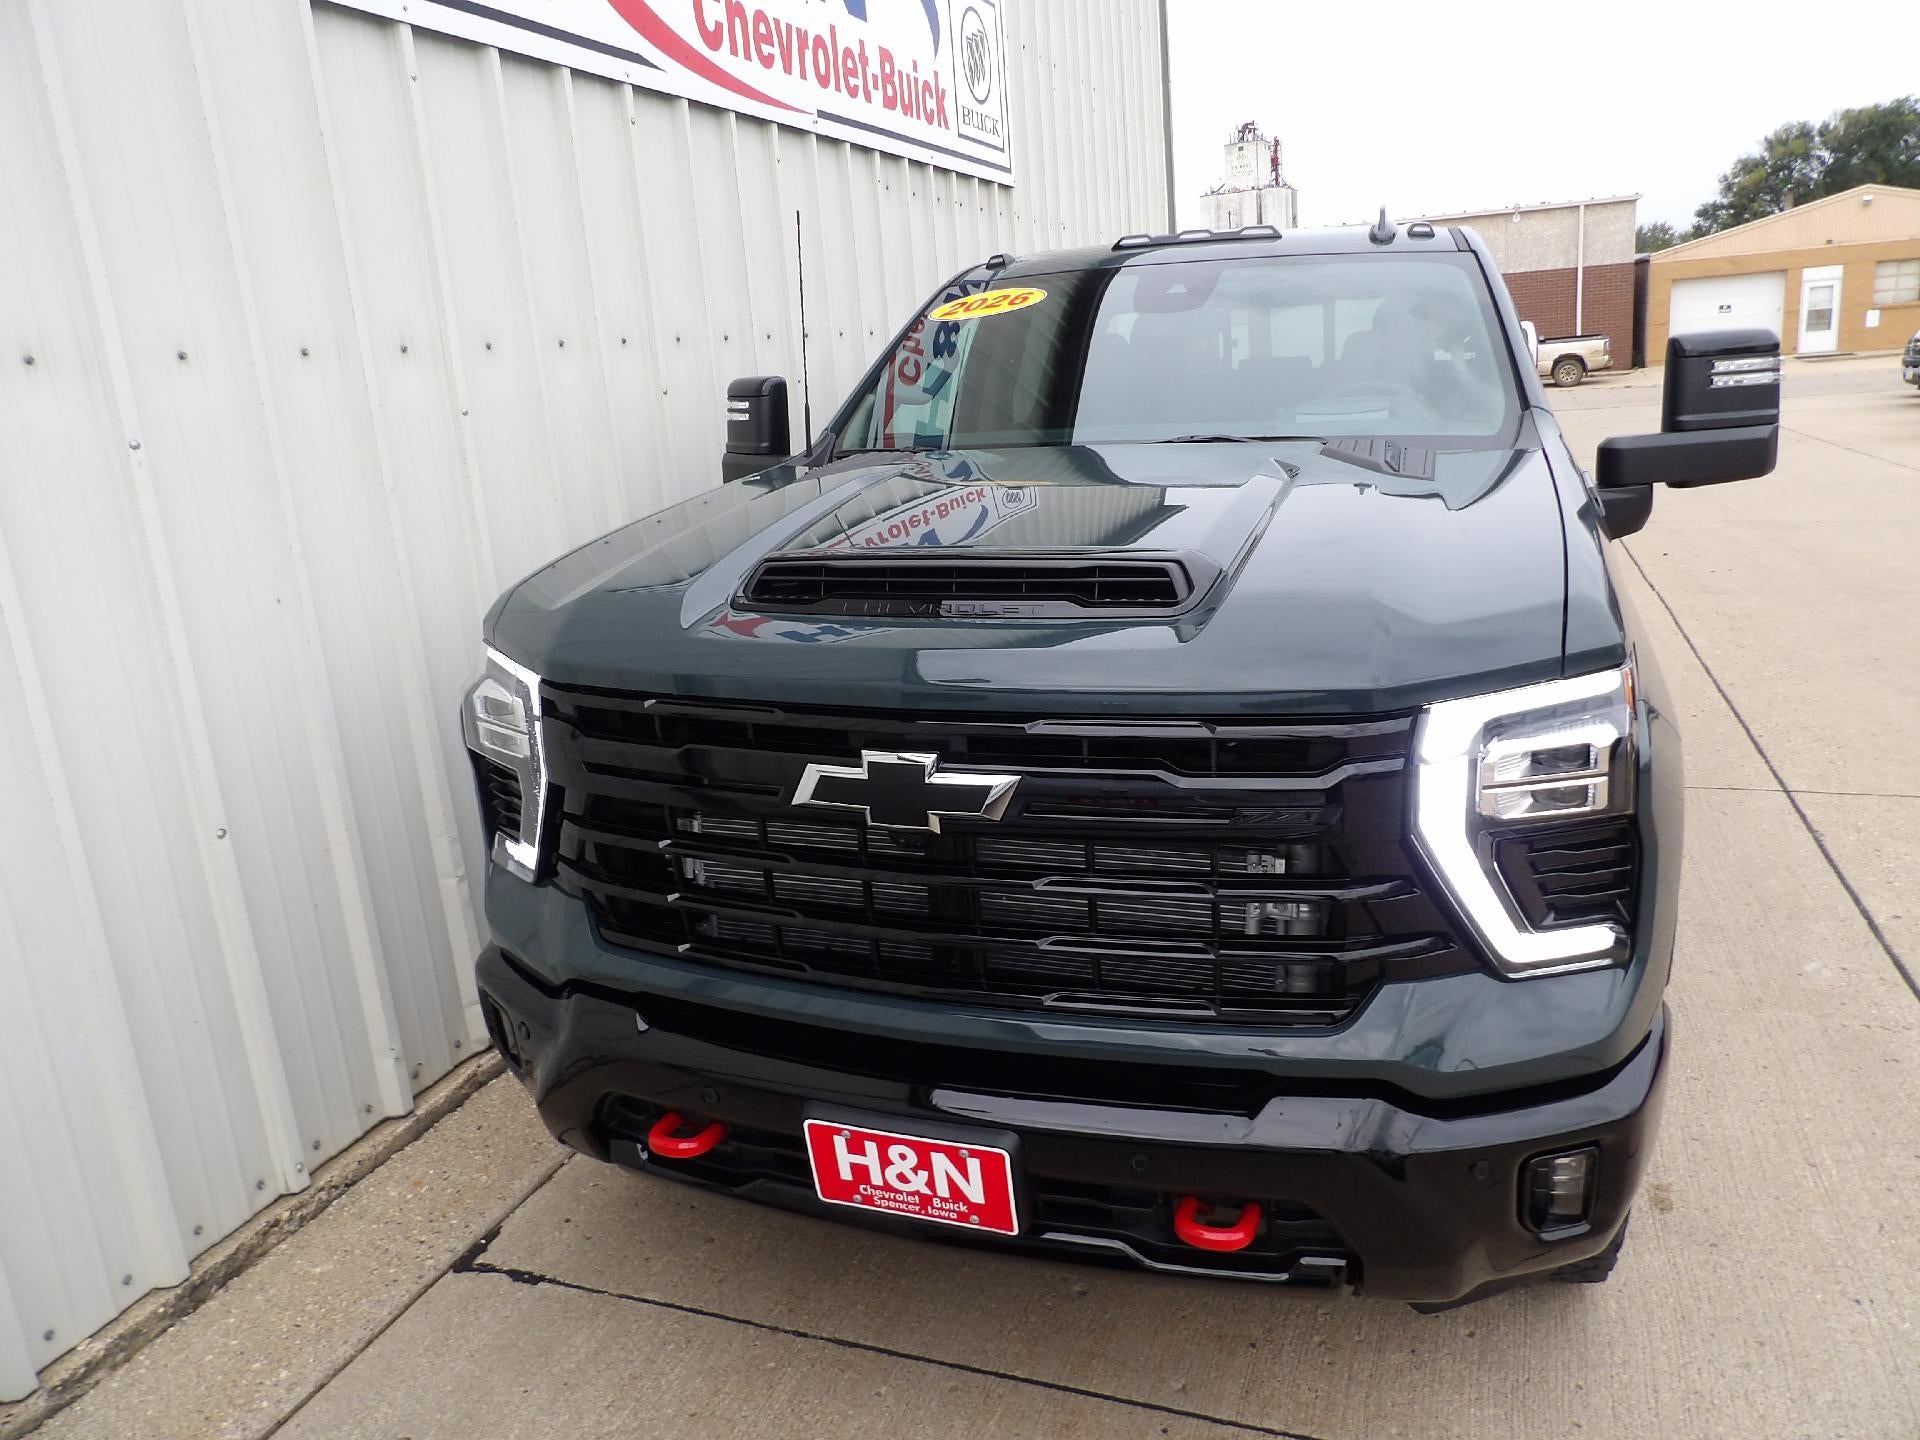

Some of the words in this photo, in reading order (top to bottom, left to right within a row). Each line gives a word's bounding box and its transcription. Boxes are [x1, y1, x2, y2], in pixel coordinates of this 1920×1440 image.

[693, 0, 950, 131] Chevrolet-Buick
[961, 105, 1000, 138] BUICK
[940, 290, 1035, 318] 2026
[833, 1134, 985, 1205] H&N
[859, 1184, 920, 1204] Chevrolet
[932, 1197, 969, 1213] Buick
[927, 1205, 958, 1219] Iowa
